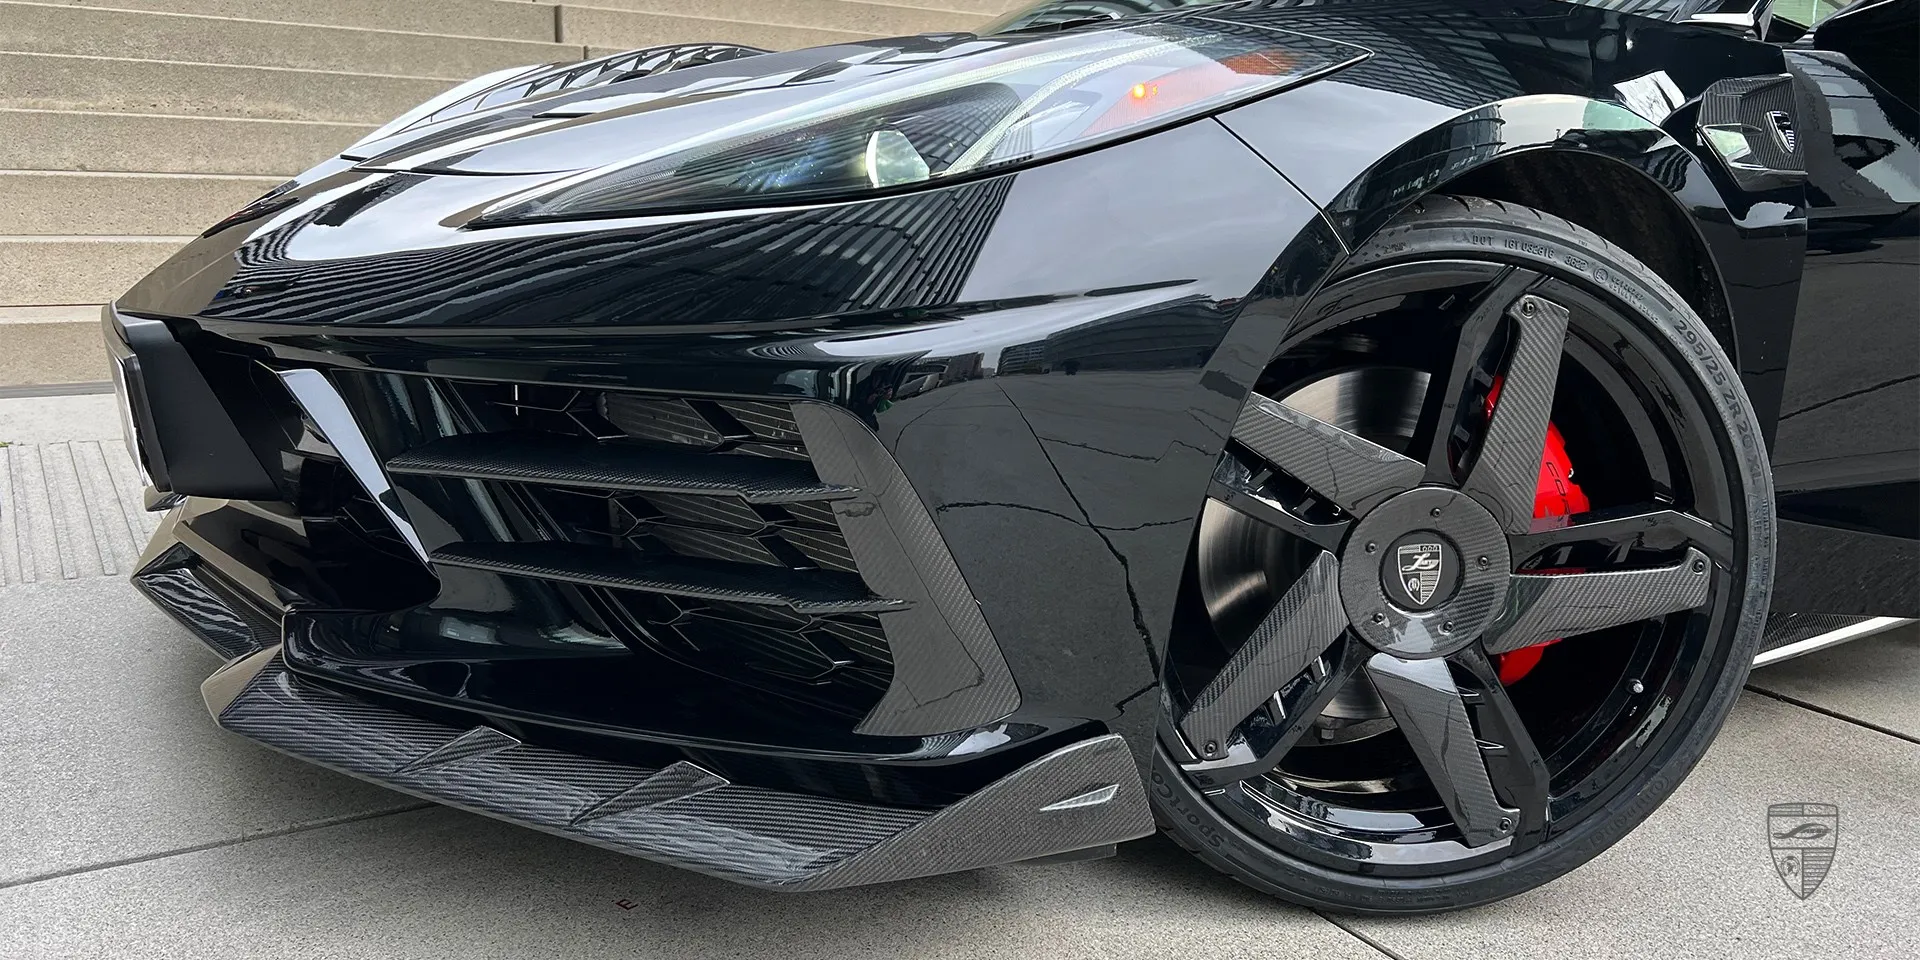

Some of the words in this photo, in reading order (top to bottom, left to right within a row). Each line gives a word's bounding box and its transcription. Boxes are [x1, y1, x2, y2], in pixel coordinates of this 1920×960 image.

[1472, 234, 1494, 246] DOT
[1673, 319, 1727, 387] 295/25
[1722, 388, 1742, 419] ZR
[1152, 765, 1225, 848] SportCo
